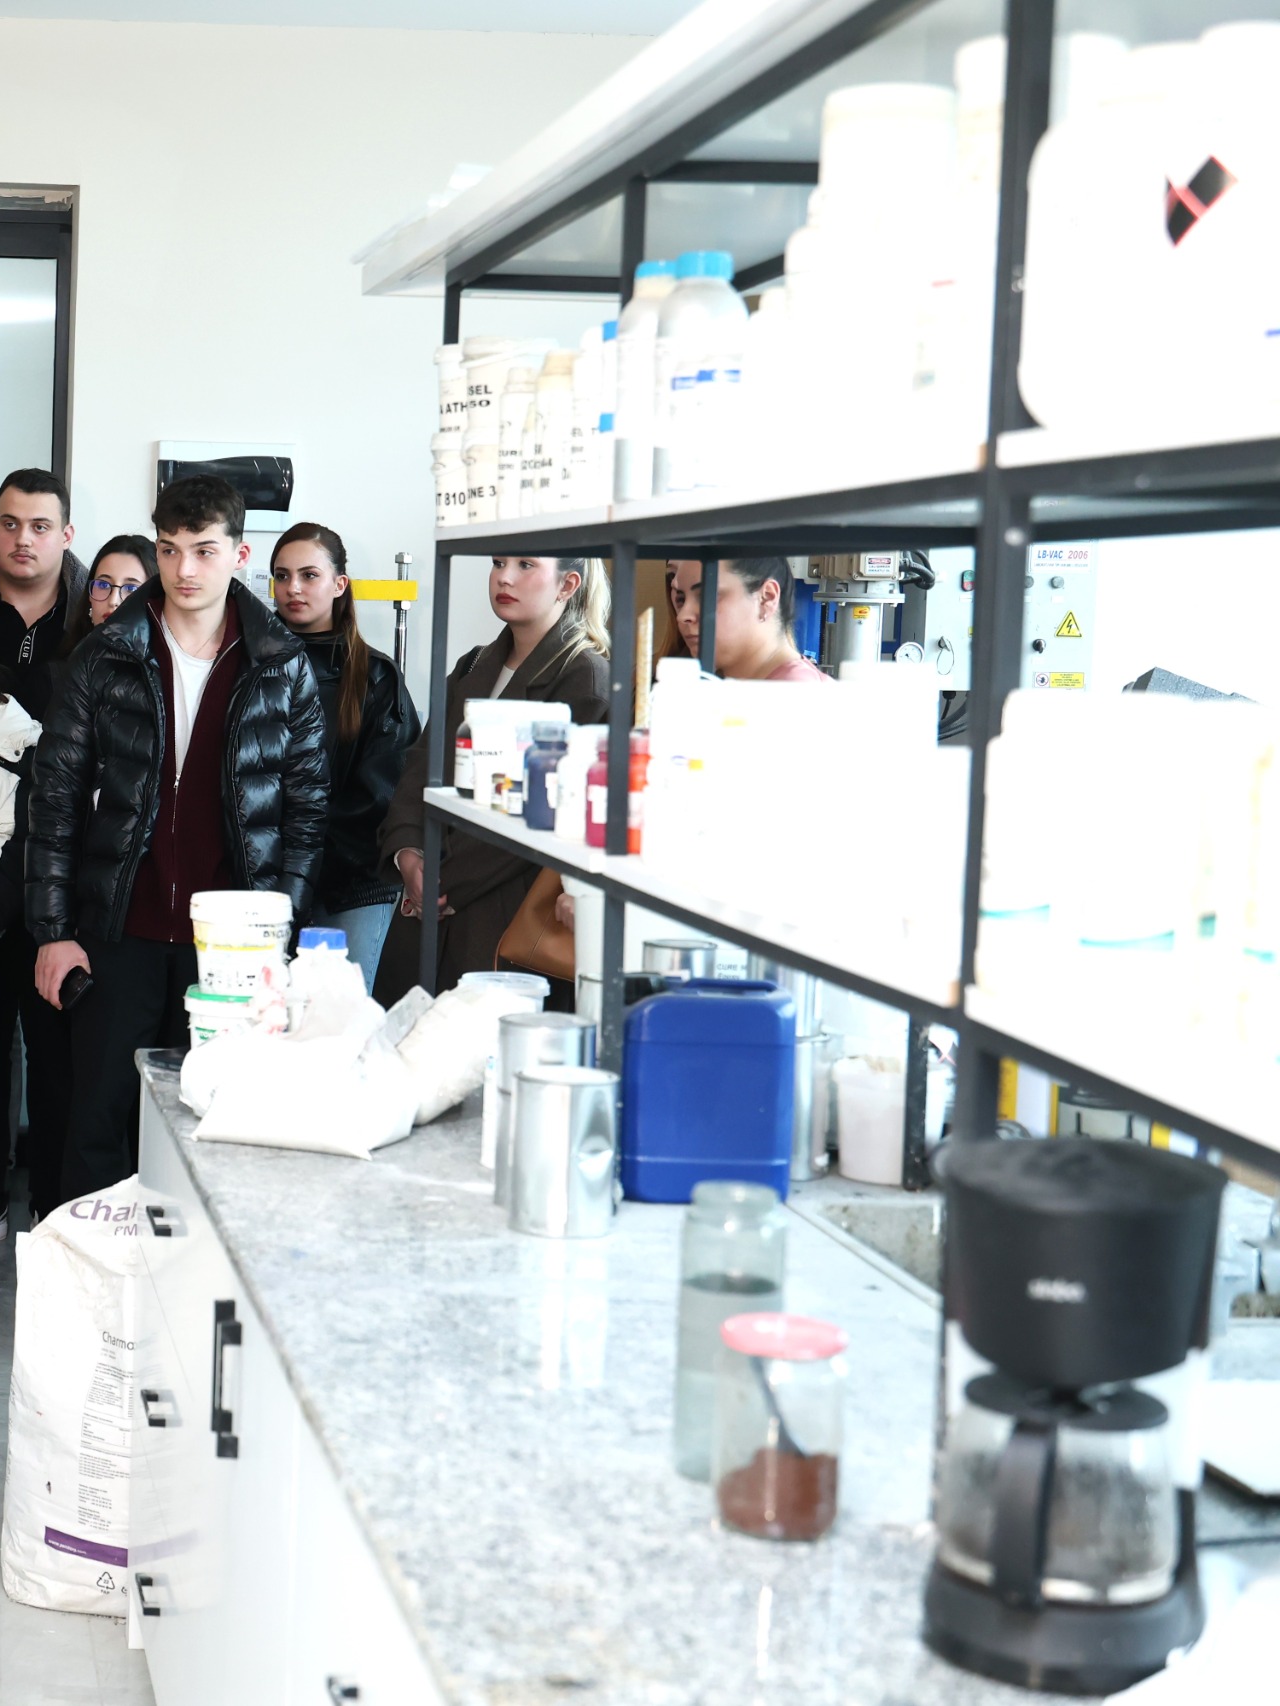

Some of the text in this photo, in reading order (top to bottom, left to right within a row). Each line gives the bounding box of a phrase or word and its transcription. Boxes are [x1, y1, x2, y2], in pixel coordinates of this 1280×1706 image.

[488, 485, 497, 498] 3
[444, 492, 466, 507] 810
[1037, 549, 1089, 560] LB-VAC 2006
[21, 635, 32, 659] CLUB
